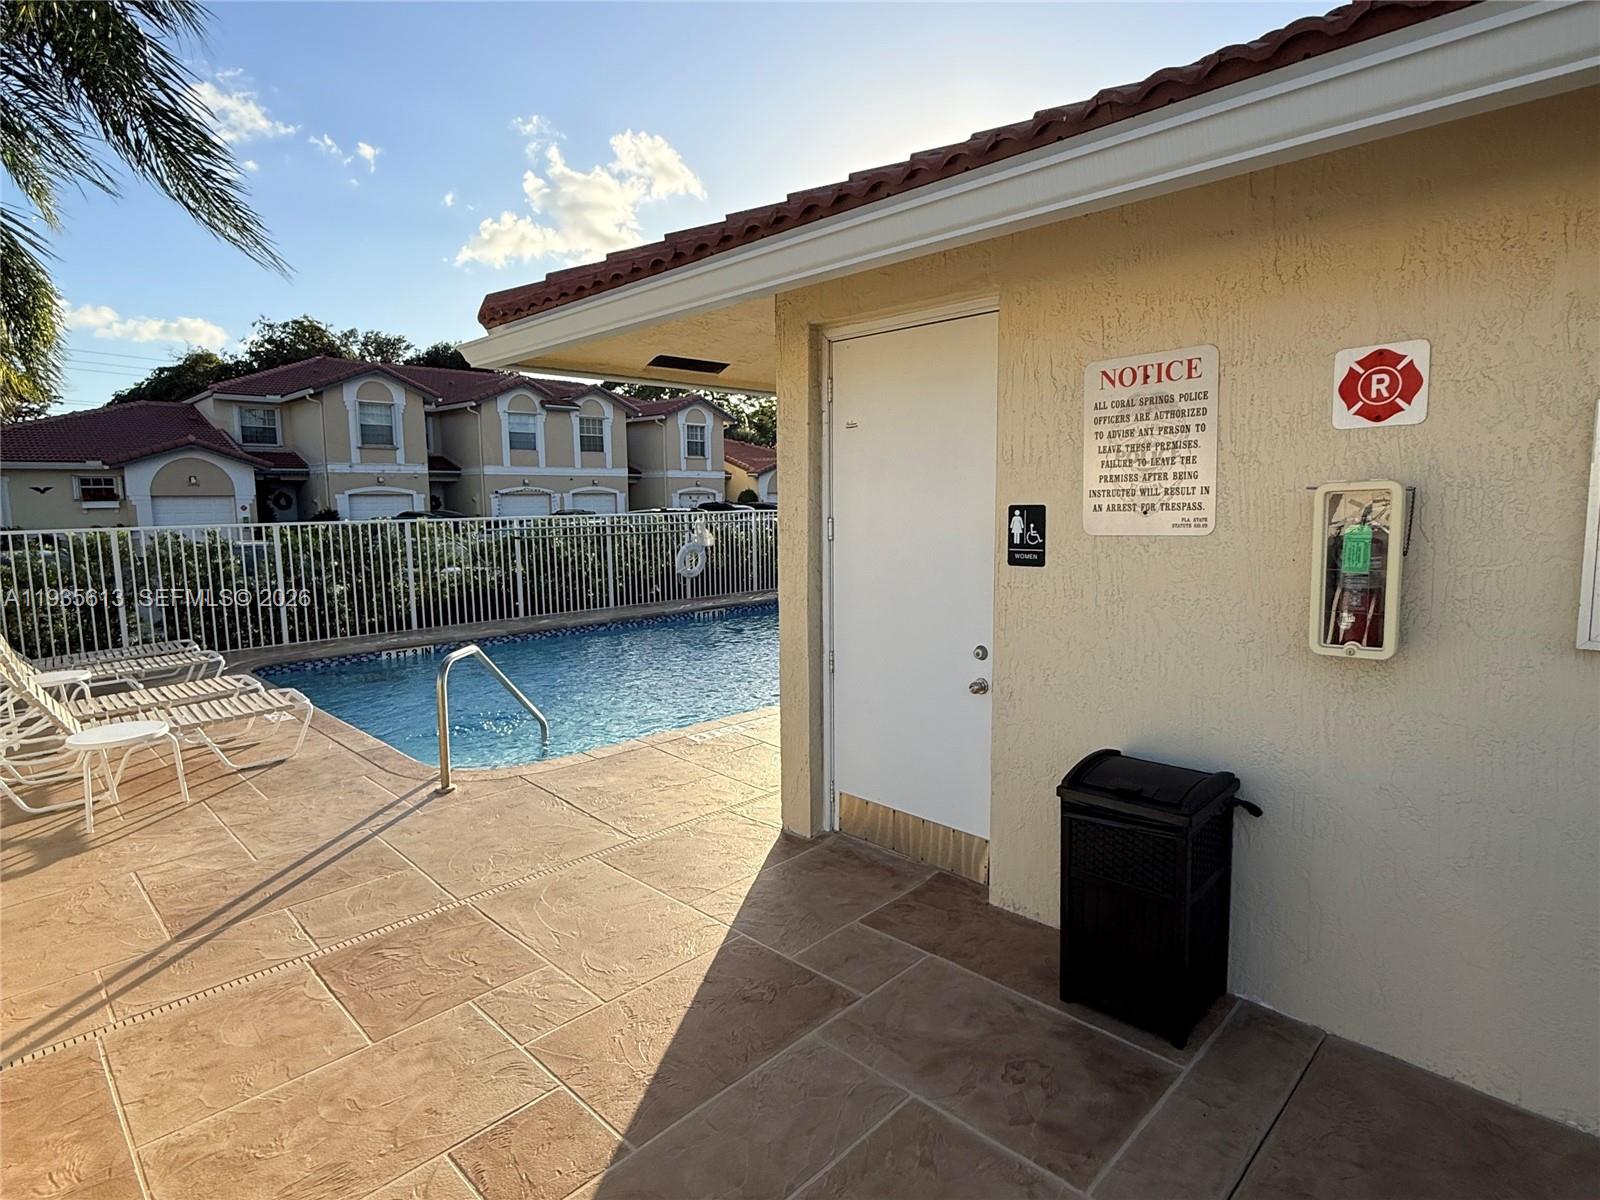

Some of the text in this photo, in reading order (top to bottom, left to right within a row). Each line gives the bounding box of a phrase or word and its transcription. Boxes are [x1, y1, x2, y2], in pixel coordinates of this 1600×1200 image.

[1100, 357, 1202, 390] NOTICE
[1370, 373, 1390, 398] R
[1094, 391, 1208, 410] ALL CORAL SPRINGS POLICE
[1094, 407, 1207, 425] OFFICERS ARE AUTHORIZED
[1095, 423, 1206, 440] TO ADVISE ANY PERSON TO
[1098, 444, 1122, 454] LEAVE
[1125, 442, 1151, 452] THESE
[1155, 440, 1201, 450] PREMISES.
[1101, 456, 1197, 469] FAILURE TO LEAVE THE
[1099, 471, 1198, 483] PREMISES AFTER BEING
[1089, 486, 1210, 498] INSTRUCTED WILL RESULT IN
[1092, 502, 1205, 512] AN ARREST FOR TRESPASS.
[396, 650, 407, 658] FT
[422, 648, 431, 656] IN
